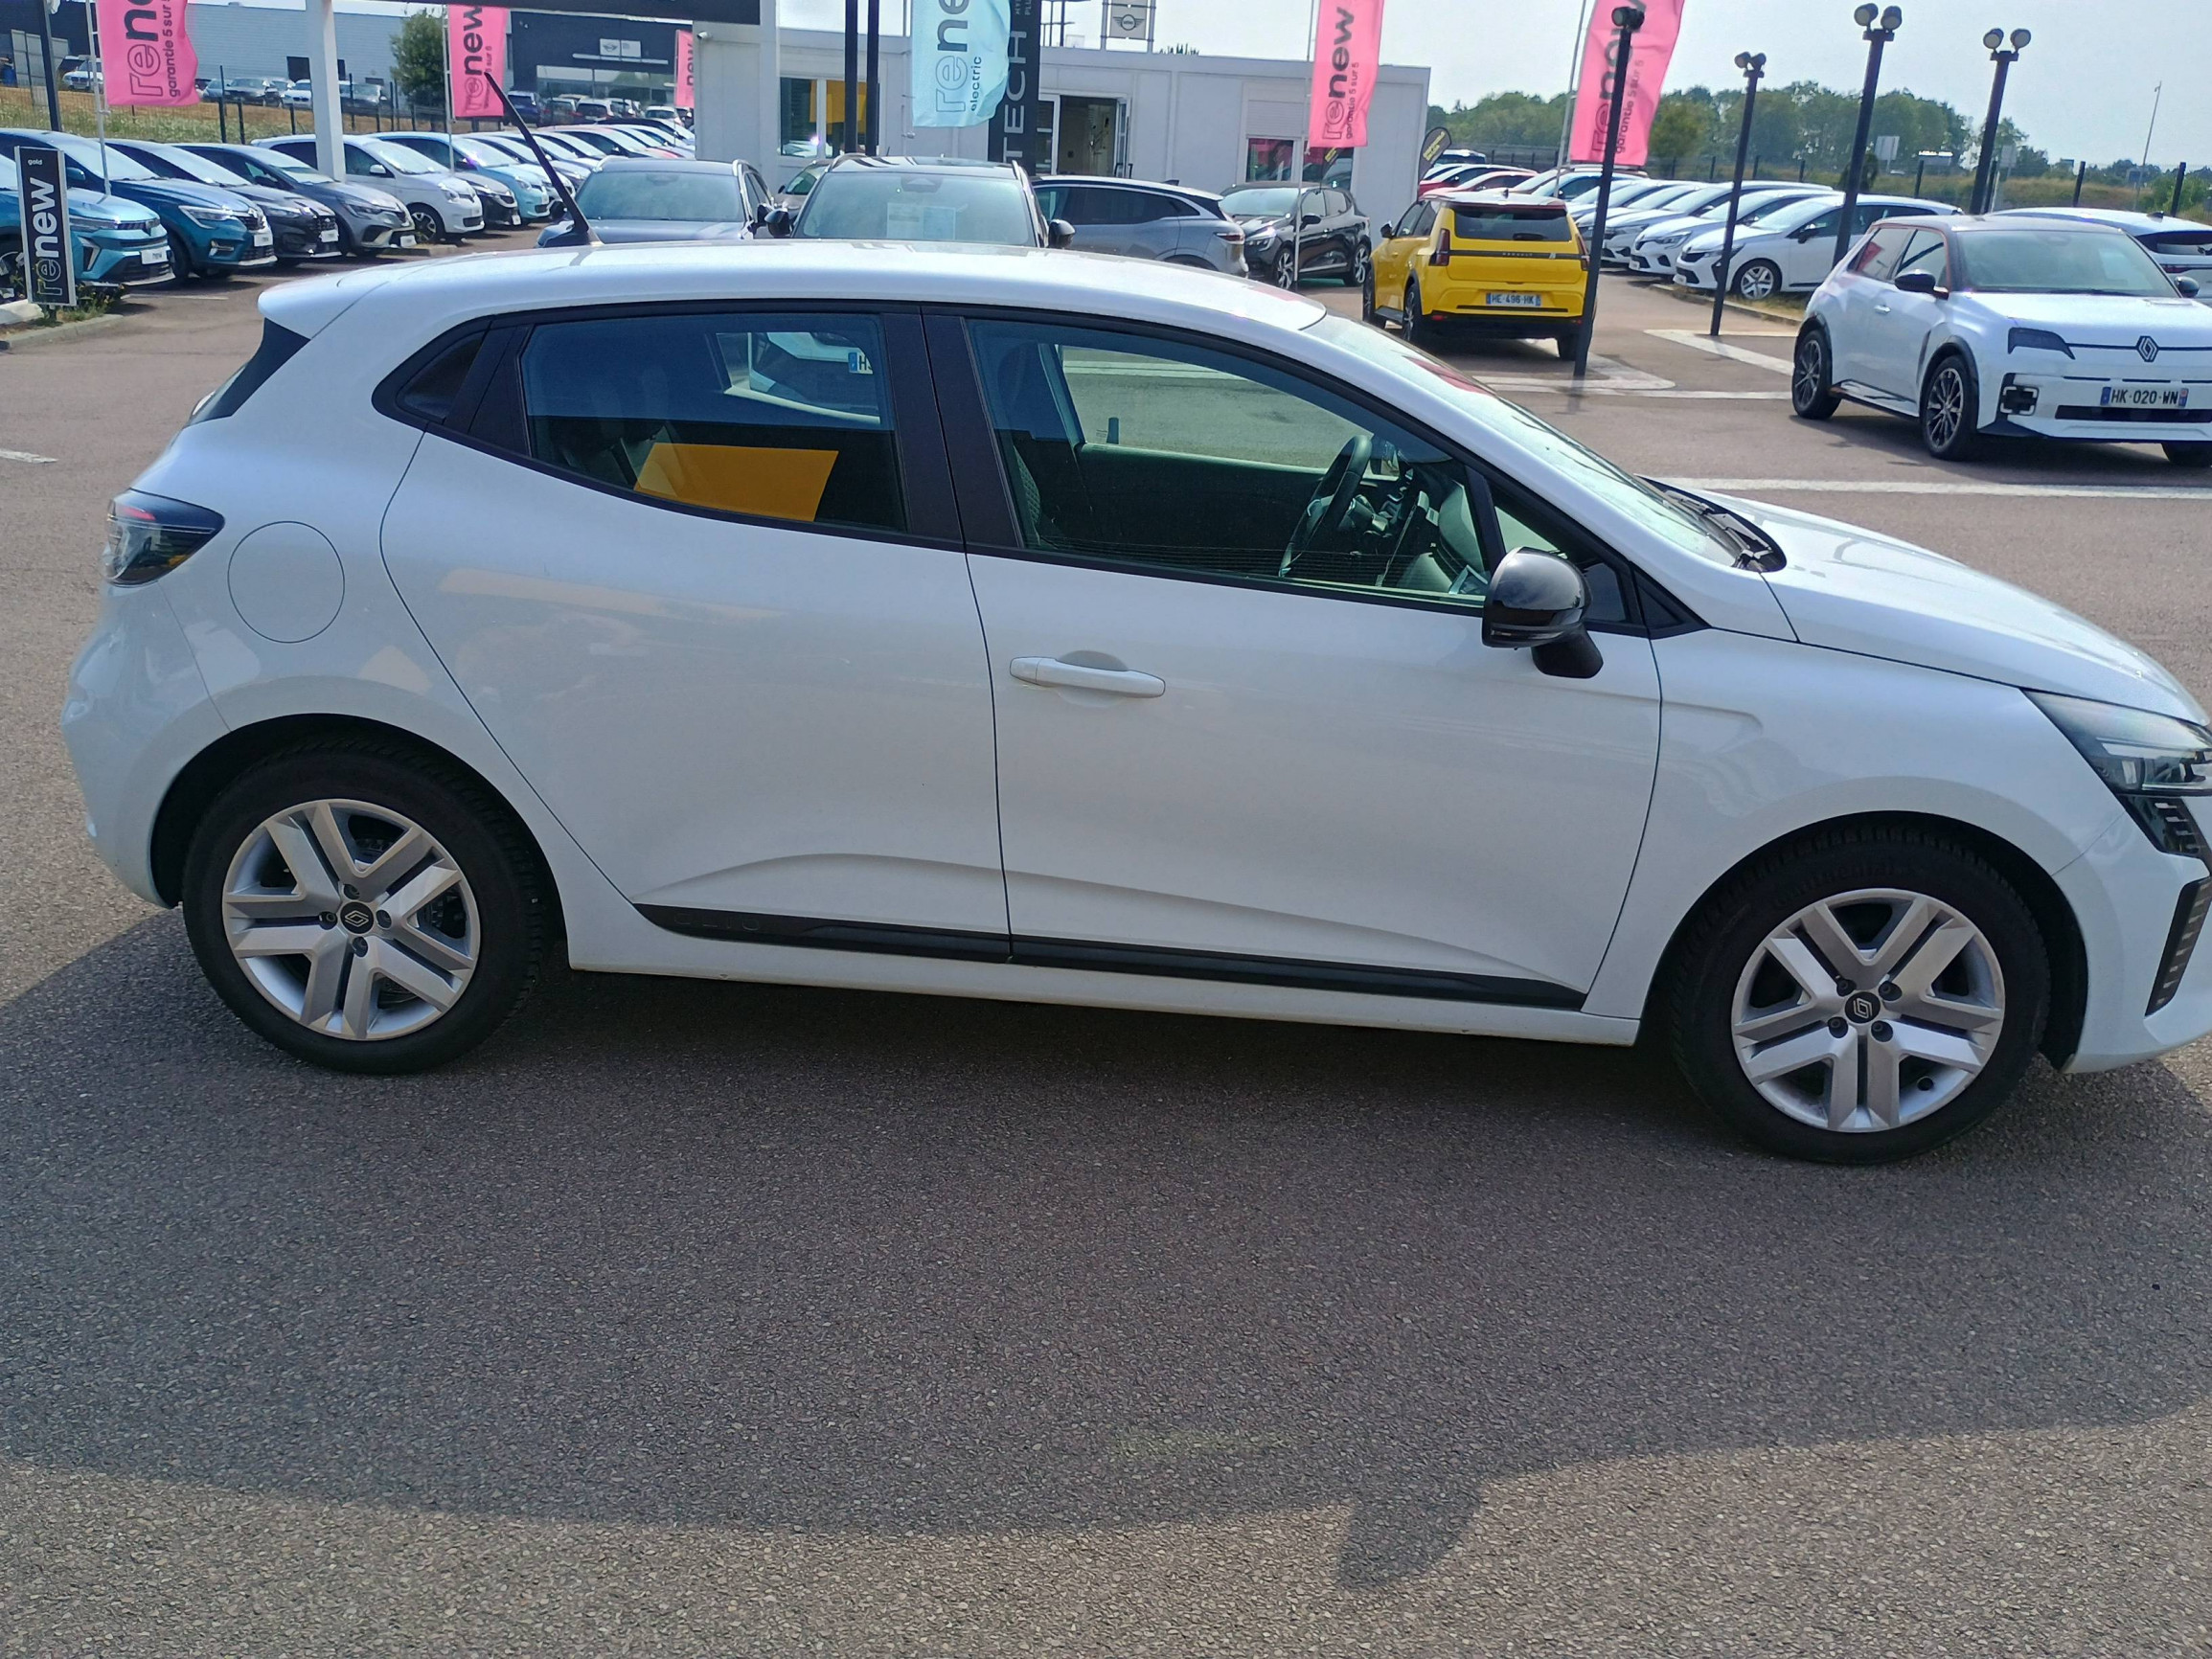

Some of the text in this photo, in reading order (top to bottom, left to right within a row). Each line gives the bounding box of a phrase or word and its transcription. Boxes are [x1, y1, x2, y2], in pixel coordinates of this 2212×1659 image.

[162, 5, 180, 97] garantie 5 sur
[970, 57, 982, 111] electric
[1322, 7, 1355, 140] renew
[30, 177, 62, 296] renew
